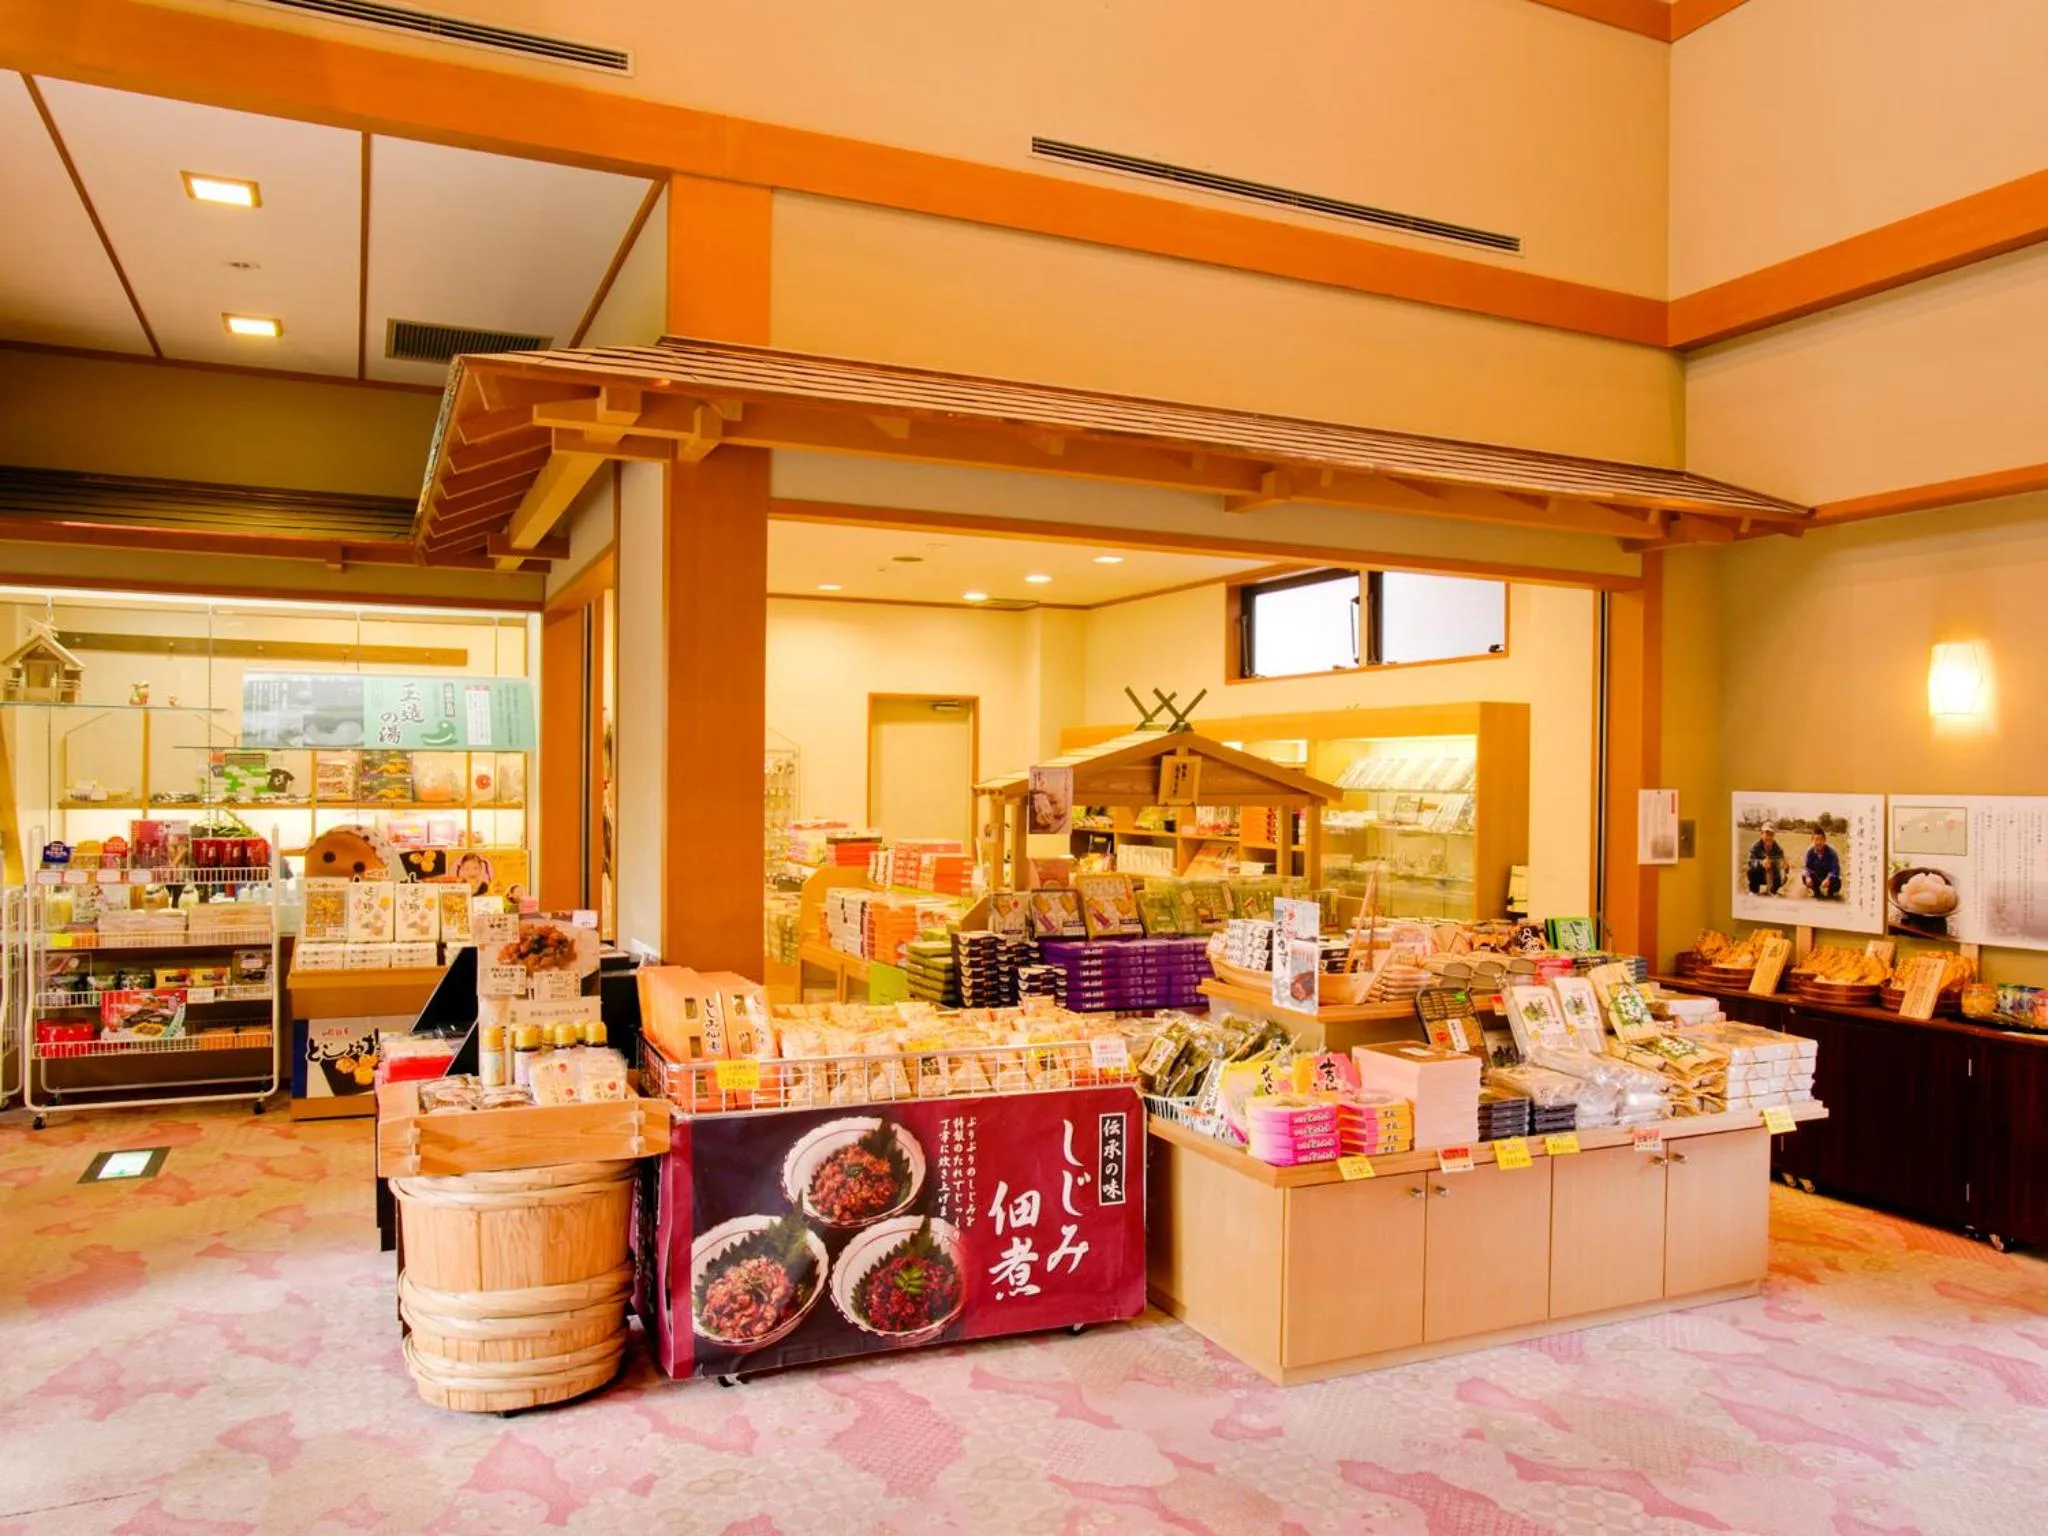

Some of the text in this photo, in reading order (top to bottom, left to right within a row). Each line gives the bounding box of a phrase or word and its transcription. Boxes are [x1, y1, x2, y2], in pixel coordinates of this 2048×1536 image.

[1047, 1119, 1091, 1273] しじみ
[1103, 1118, 1121, 1199] 伝承の味
[988, 1180, 1042, 1300] 佃煮
